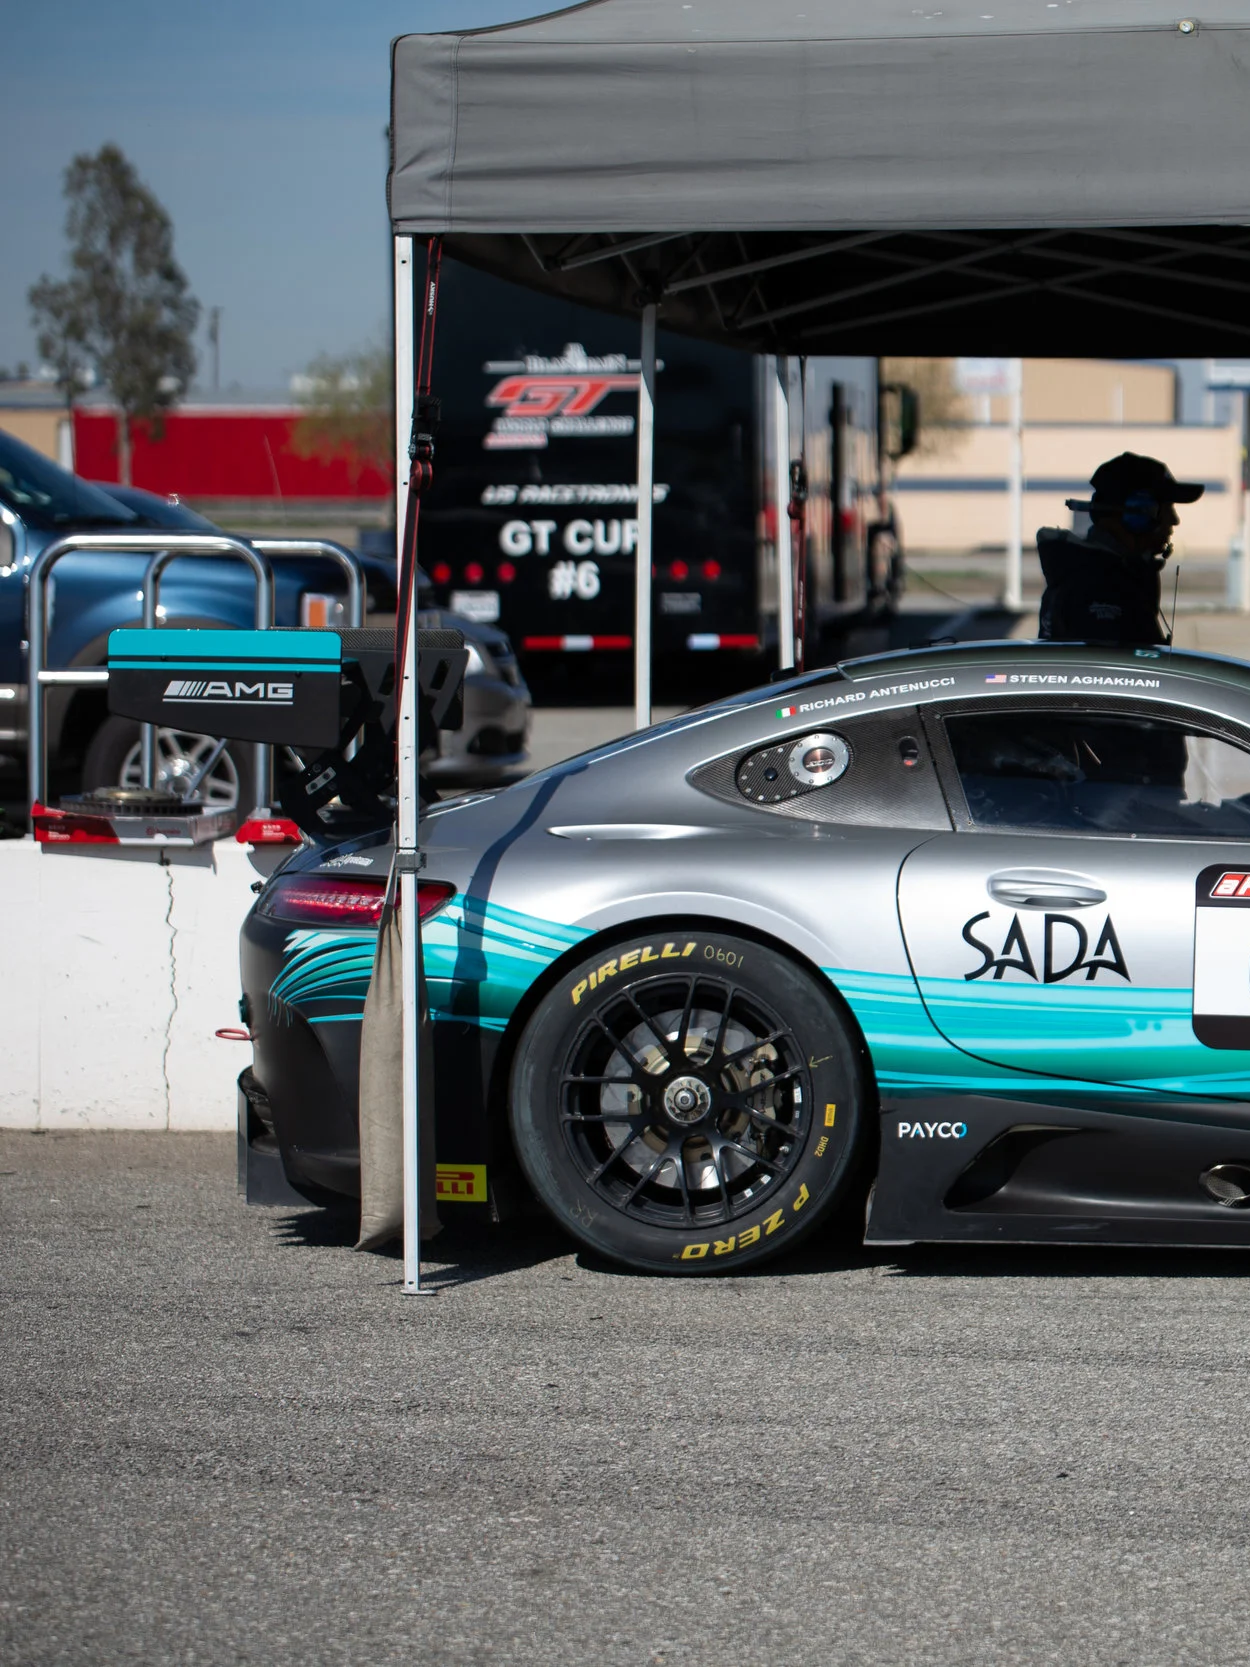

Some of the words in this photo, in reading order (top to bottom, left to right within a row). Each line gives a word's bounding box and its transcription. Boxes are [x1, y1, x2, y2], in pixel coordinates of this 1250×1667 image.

[428, 281, 436, 306] HUSKY
[499, 520, 556, 556] GT
[549, 561, 601, 600] #6
[202, 681, 293, 699] AMG
[799, 692, 866, 714] RICHARD
[870, 677, 956, 698] ANTENUCCI
[1010, 674, 1068, 685] STEVEN
[1071, 675, 1160, 688] AGHAKHANI
[703, 944, 744, 969] 0601
[961, 911, 1132, 984] SADA
[570, 942, 697, 1006] PIRELLI
[898, 1122, 967, 1138] PAYCO
[793, 1182, 811, 1212] P
[680, 1216, 786, 1261] ZERO
